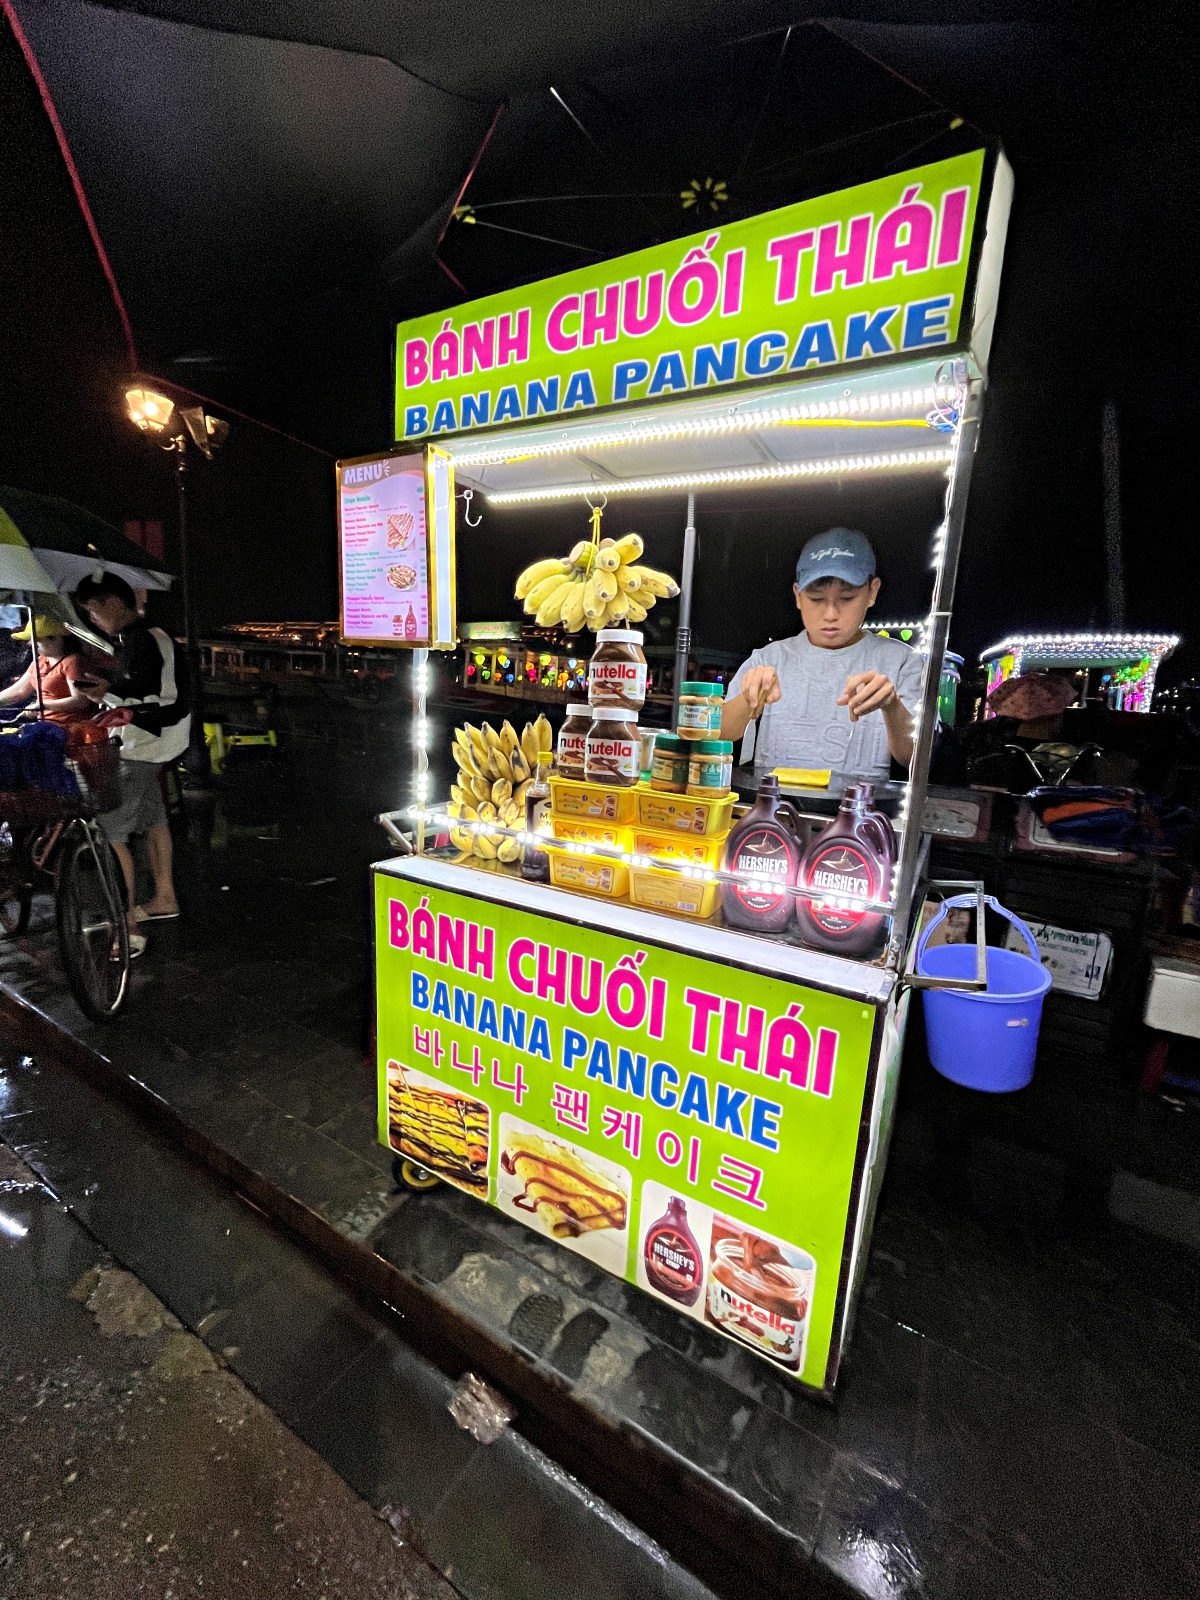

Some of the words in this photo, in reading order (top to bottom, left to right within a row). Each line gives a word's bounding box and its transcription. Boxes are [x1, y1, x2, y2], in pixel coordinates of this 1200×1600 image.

[405, 309, 529, 387] BÁNH
[546, 235, 744, 353] CHUỐI
[769, 184, 968, 302] THÁI
[405, 371, 596, 437] BANANA
[613, 297, 953, 401] PANCAKE
[344, 463, 383, 485] MENU
[590, 663, 637, 680] nutella
[738, 854, 788, 874] HERSHEY'S
[814, 870, 869, 895] HERSHEY'S
[388, 897, 495, 980] BÁNH
[507, 938, 667, 1039] CHUỐI
[685, 988, 838, 1097] THÁI
[411, 972, 552, 1060] BANANA
[562, 1029, 782, 1151] PANCAKE
[414, 1026, 528, 1104] 바나나
[653, 1242, 695, 1272] HERSHEY'S
[720, 1287, 796, 1336] nutella
